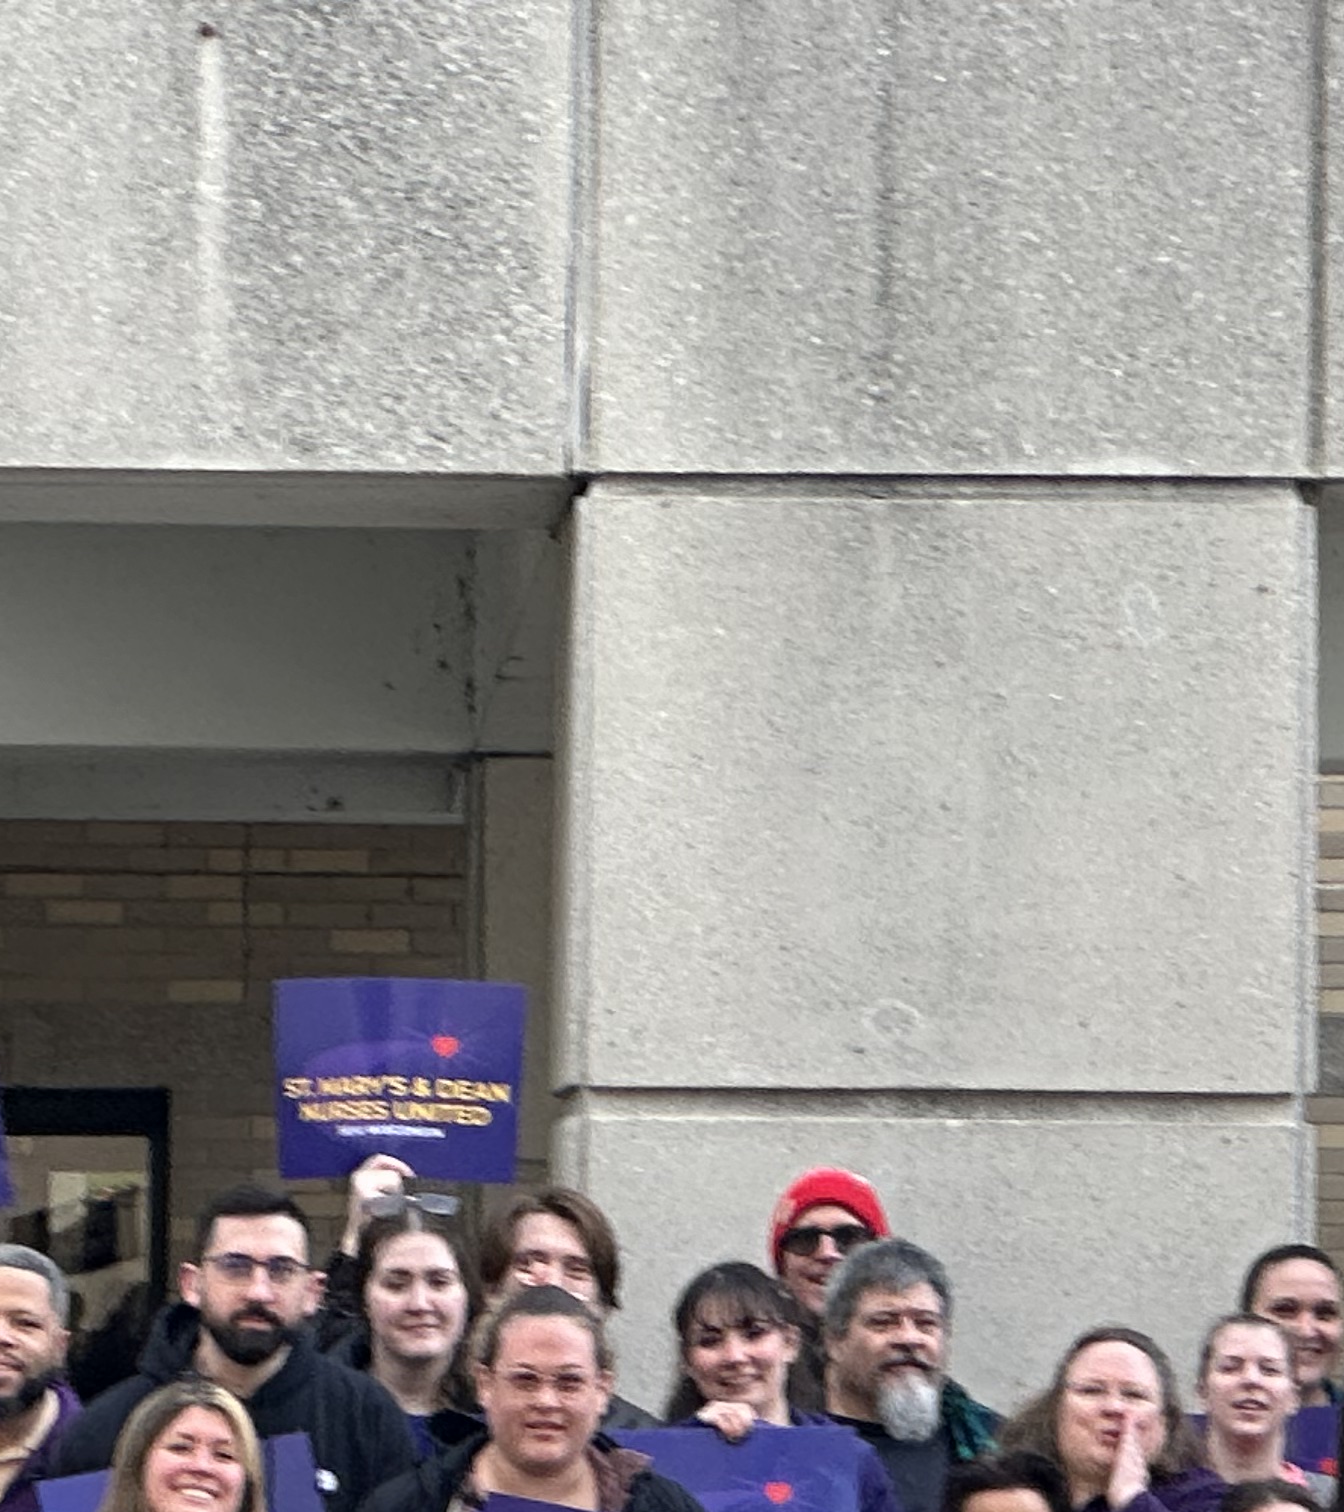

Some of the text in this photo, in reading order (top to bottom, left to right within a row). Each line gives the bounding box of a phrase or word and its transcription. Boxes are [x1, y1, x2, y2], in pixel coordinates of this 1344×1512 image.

[412, 1076, 431, 1098] &
[434, 1078, 511, 1103] DEAN
[299, 1101, 493, 1126] NURSES UNITED
